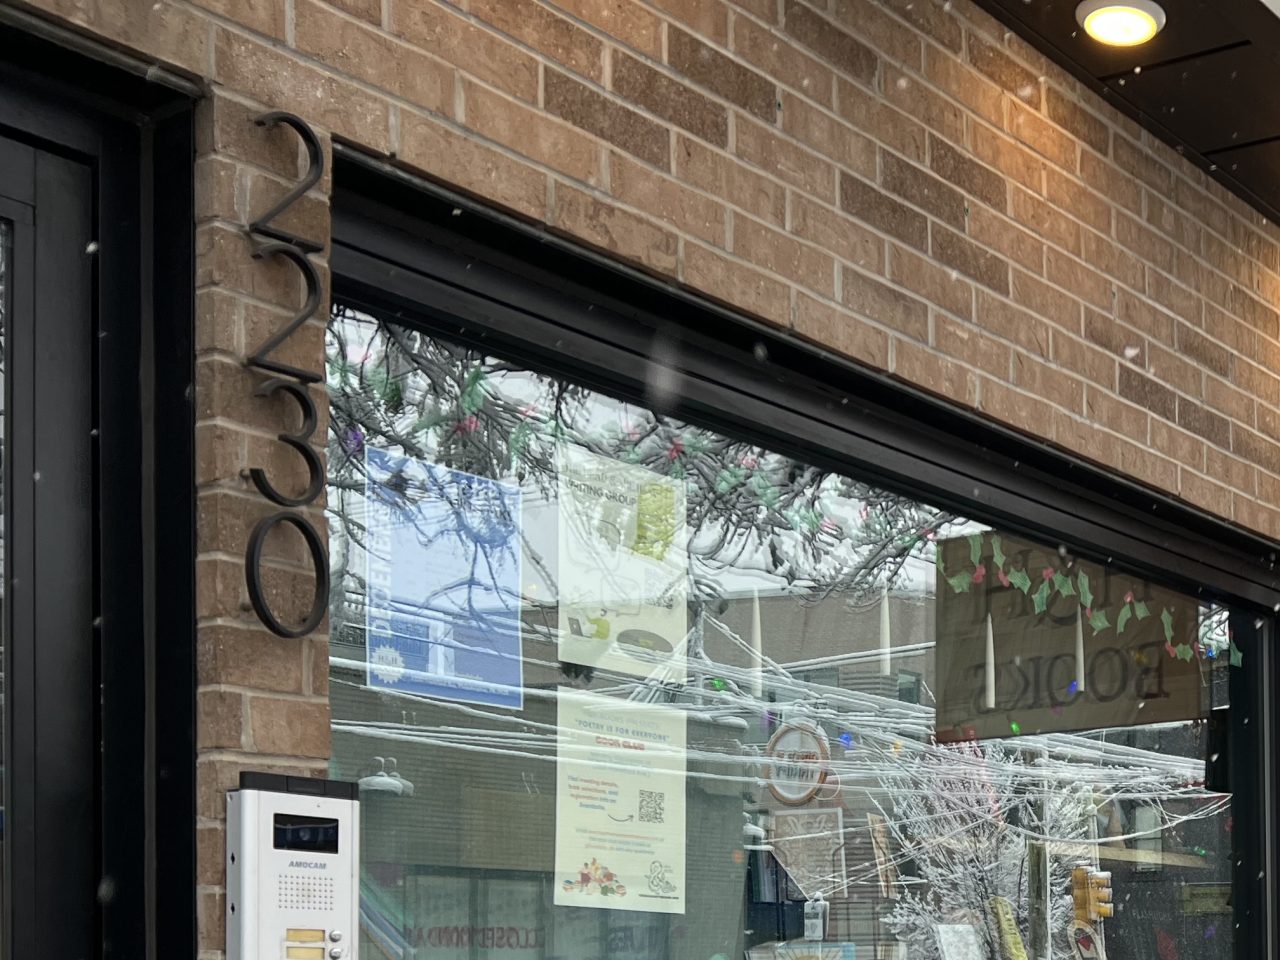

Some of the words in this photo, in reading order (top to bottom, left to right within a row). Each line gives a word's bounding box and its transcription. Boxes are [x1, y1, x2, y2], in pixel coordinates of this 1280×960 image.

[245, 111, 330, 639] 2230
[616, 726, 630, 735] FOR
[288, 860, 327, 870] AMOCAM
